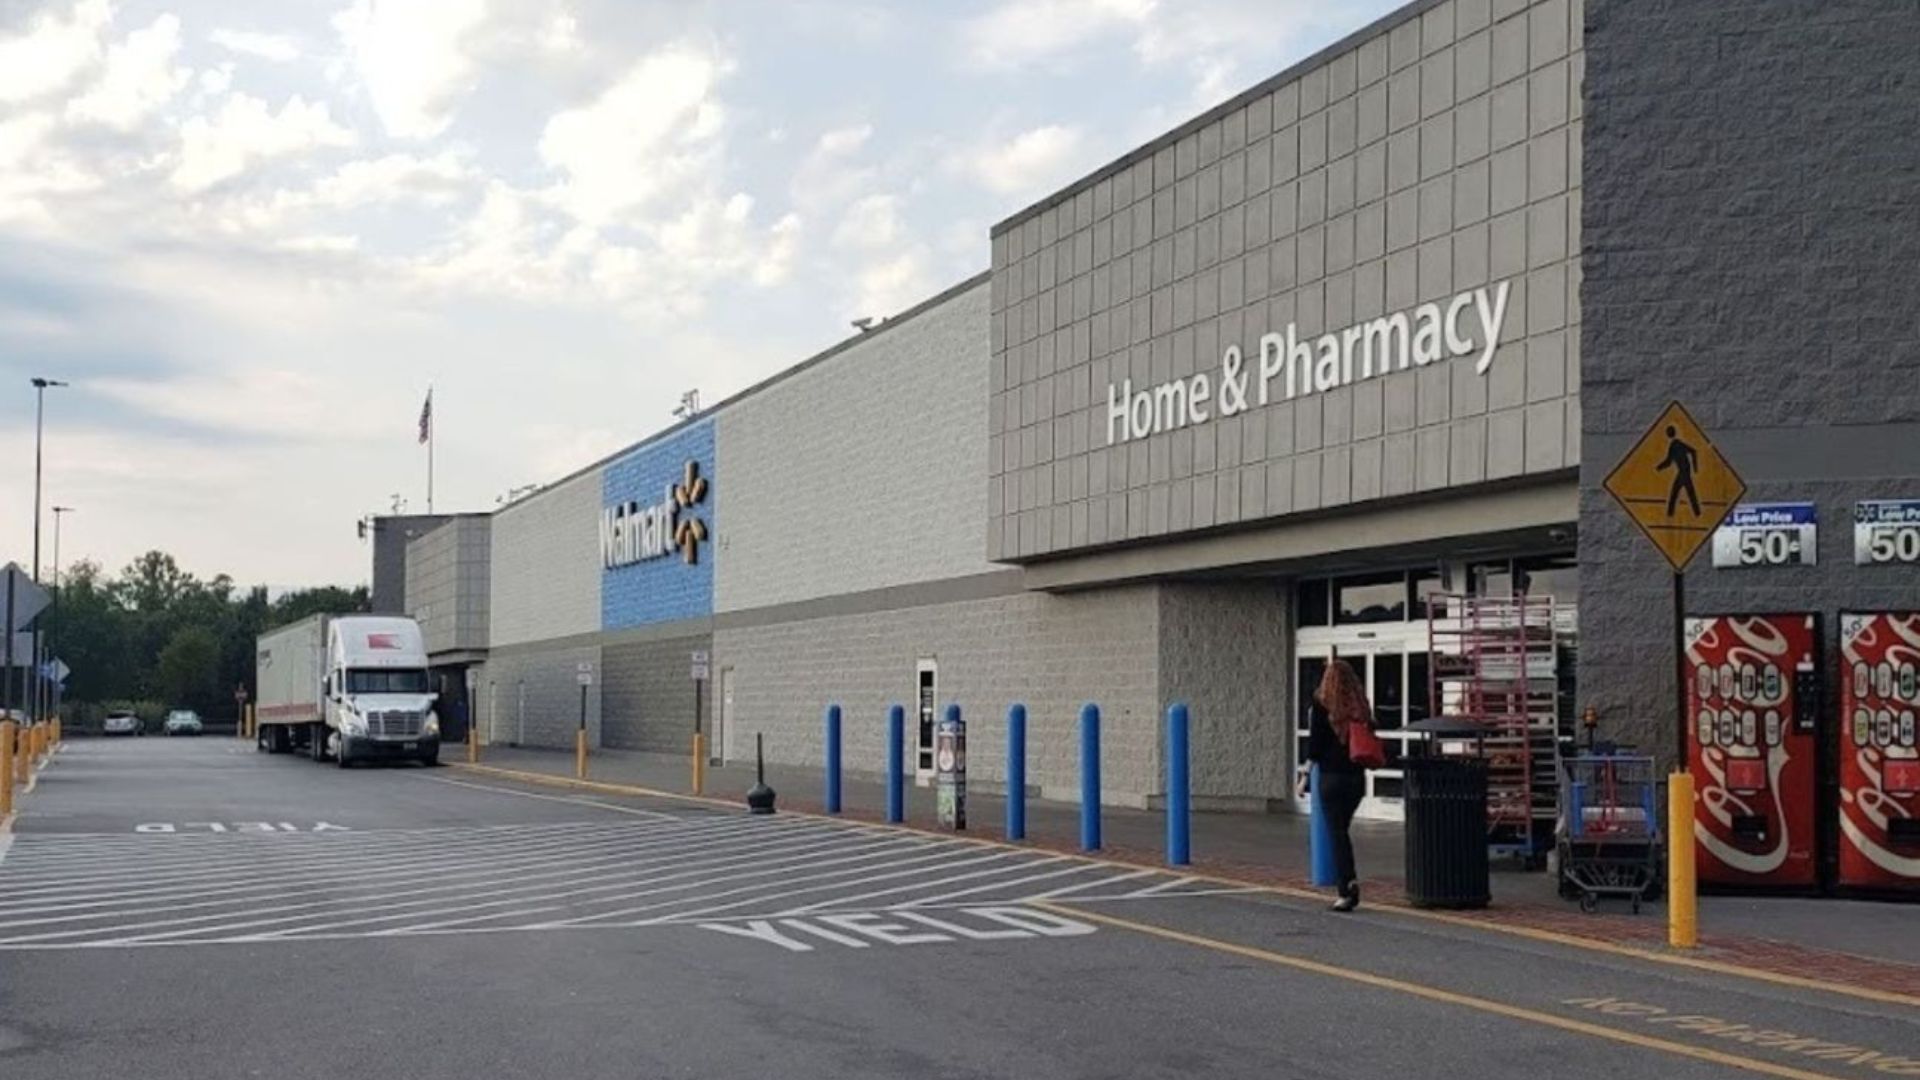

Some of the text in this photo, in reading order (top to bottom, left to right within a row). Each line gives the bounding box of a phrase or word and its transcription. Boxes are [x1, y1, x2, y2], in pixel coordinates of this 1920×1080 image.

[1107, 280, 1511, 445] Home & Pharmacy
[598, 484, 676, 569] Walmart
[1733, 511, 1793, 523] Low Price
[1878, 507, 1905, 520] Low
[134, 820, 351, 832] YIELD
[695, 906, 1098, 951] YIELD
